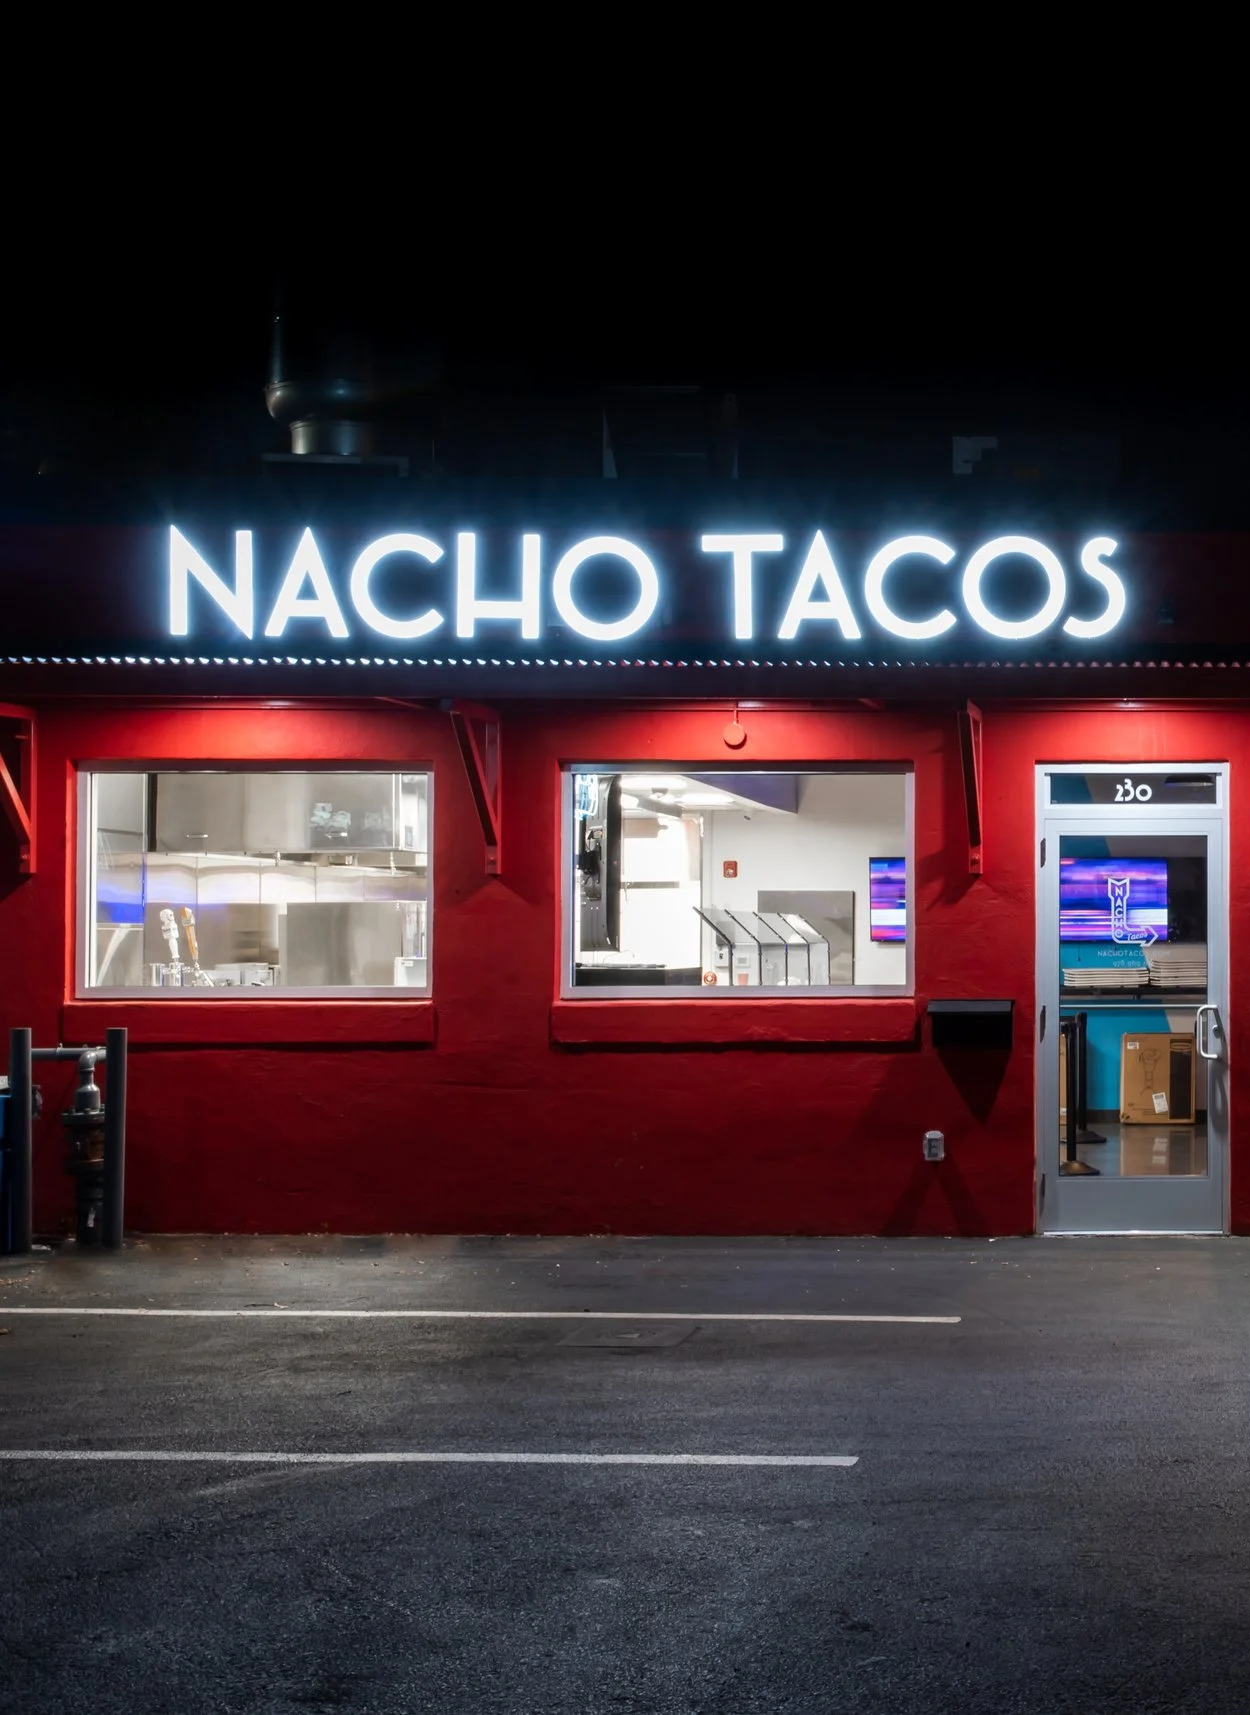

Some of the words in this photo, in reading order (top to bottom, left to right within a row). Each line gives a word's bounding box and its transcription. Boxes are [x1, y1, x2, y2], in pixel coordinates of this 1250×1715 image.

[170, 525, 659, 641] NACHO
[701, 529, 1126, 641] TACOS
[1114, 778, 1152, 801] 230
[1114, 886, 1124, 938] NACHO
